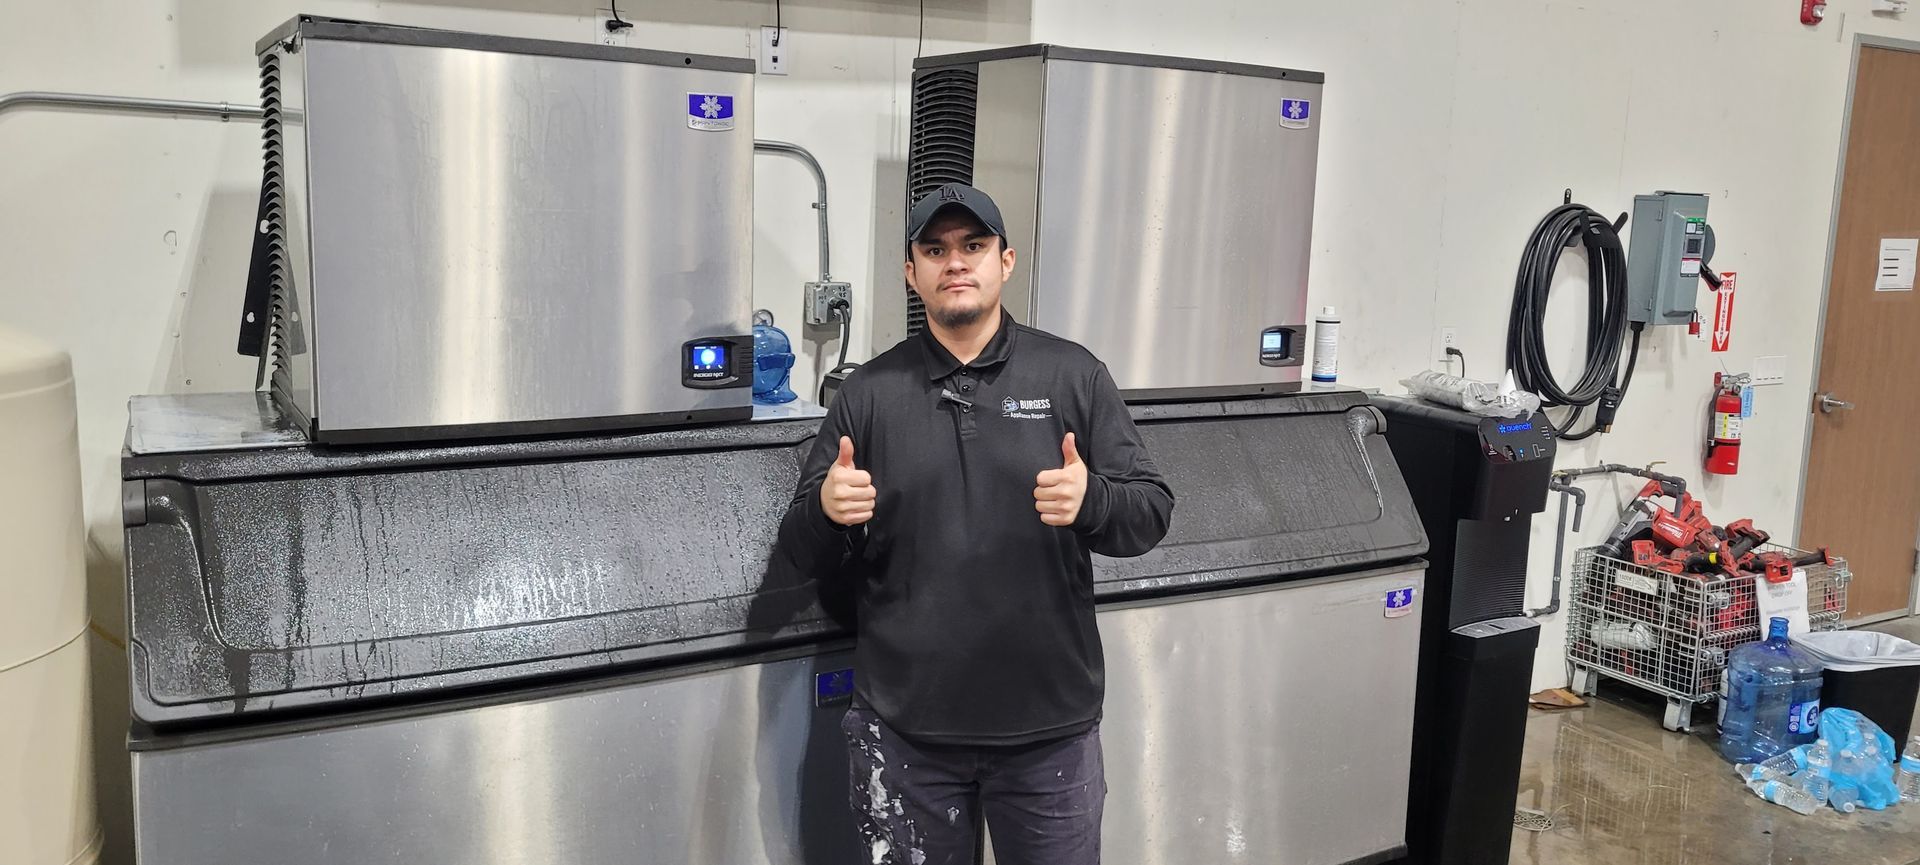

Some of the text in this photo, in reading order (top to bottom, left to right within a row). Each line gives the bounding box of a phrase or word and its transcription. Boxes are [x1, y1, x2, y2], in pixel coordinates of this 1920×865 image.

[1721, 279, 1734, 290] FIRE
[1019, 399, 1051, 409] BURGESS
[1506, 422, 1533, 432] quench
